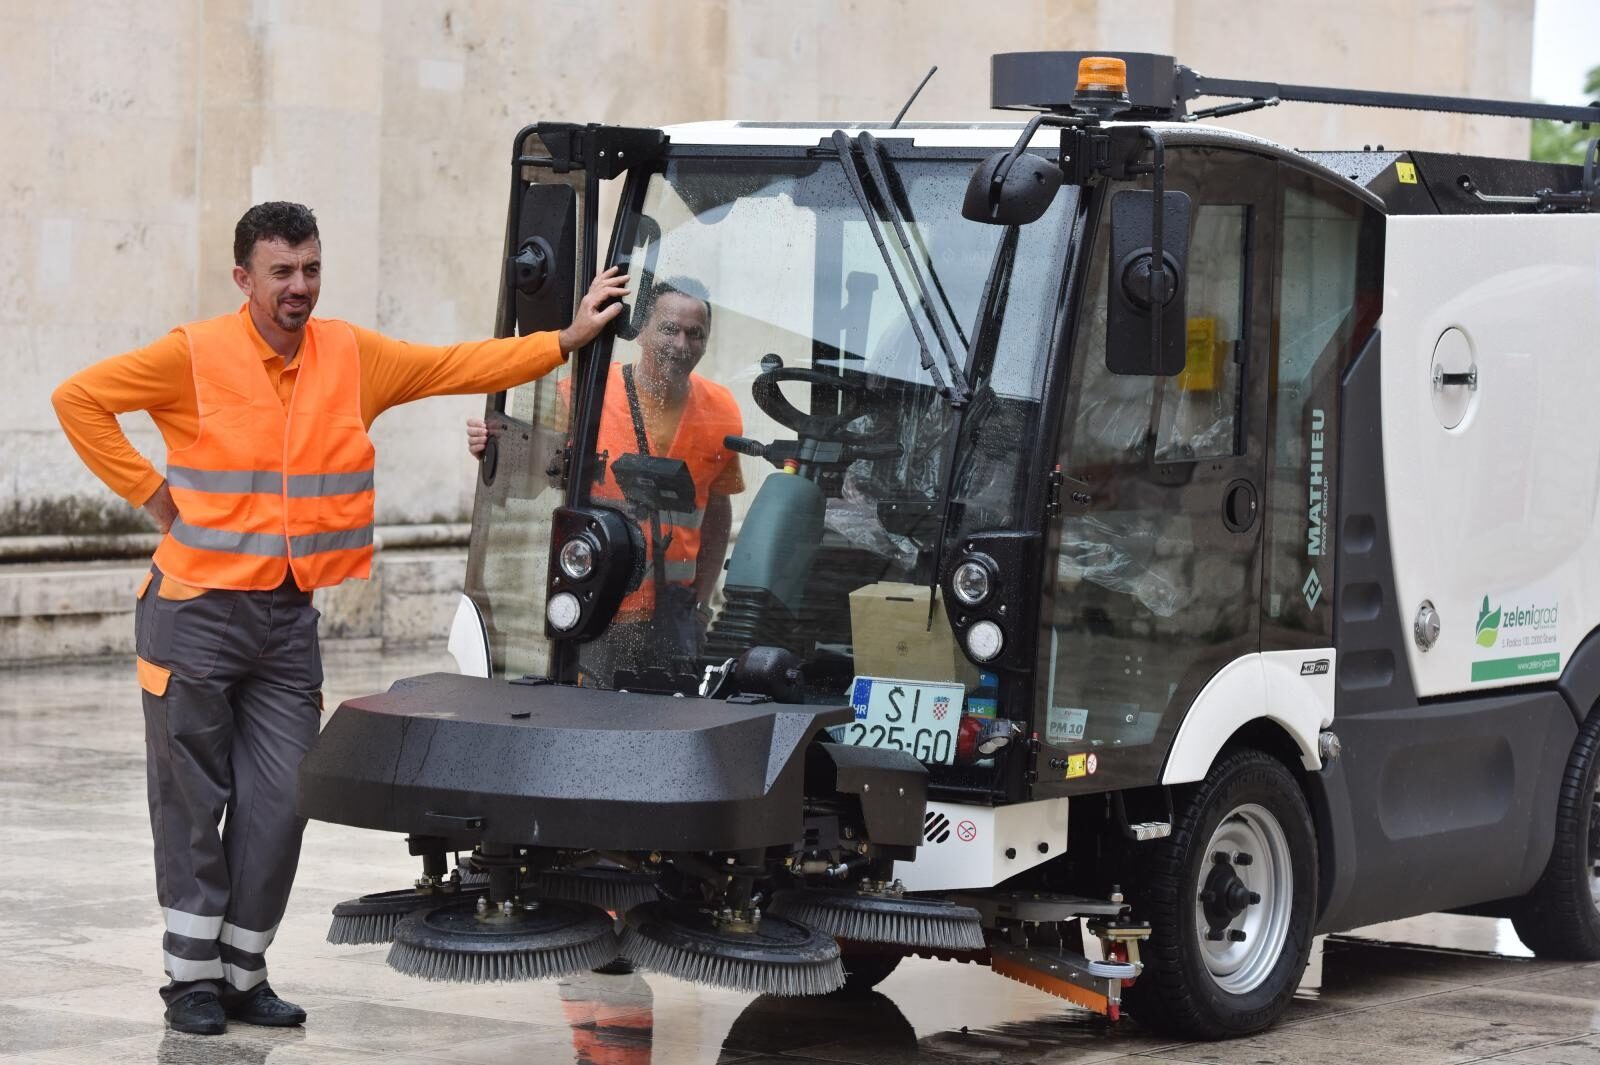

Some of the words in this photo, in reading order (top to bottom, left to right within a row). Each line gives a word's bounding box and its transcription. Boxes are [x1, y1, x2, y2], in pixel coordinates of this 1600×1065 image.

[1307, 409, 1325, 556] MATHIEU
[1502, 601, 1559, 630] zelenigrad
[853, 703, 867, 715] HR
